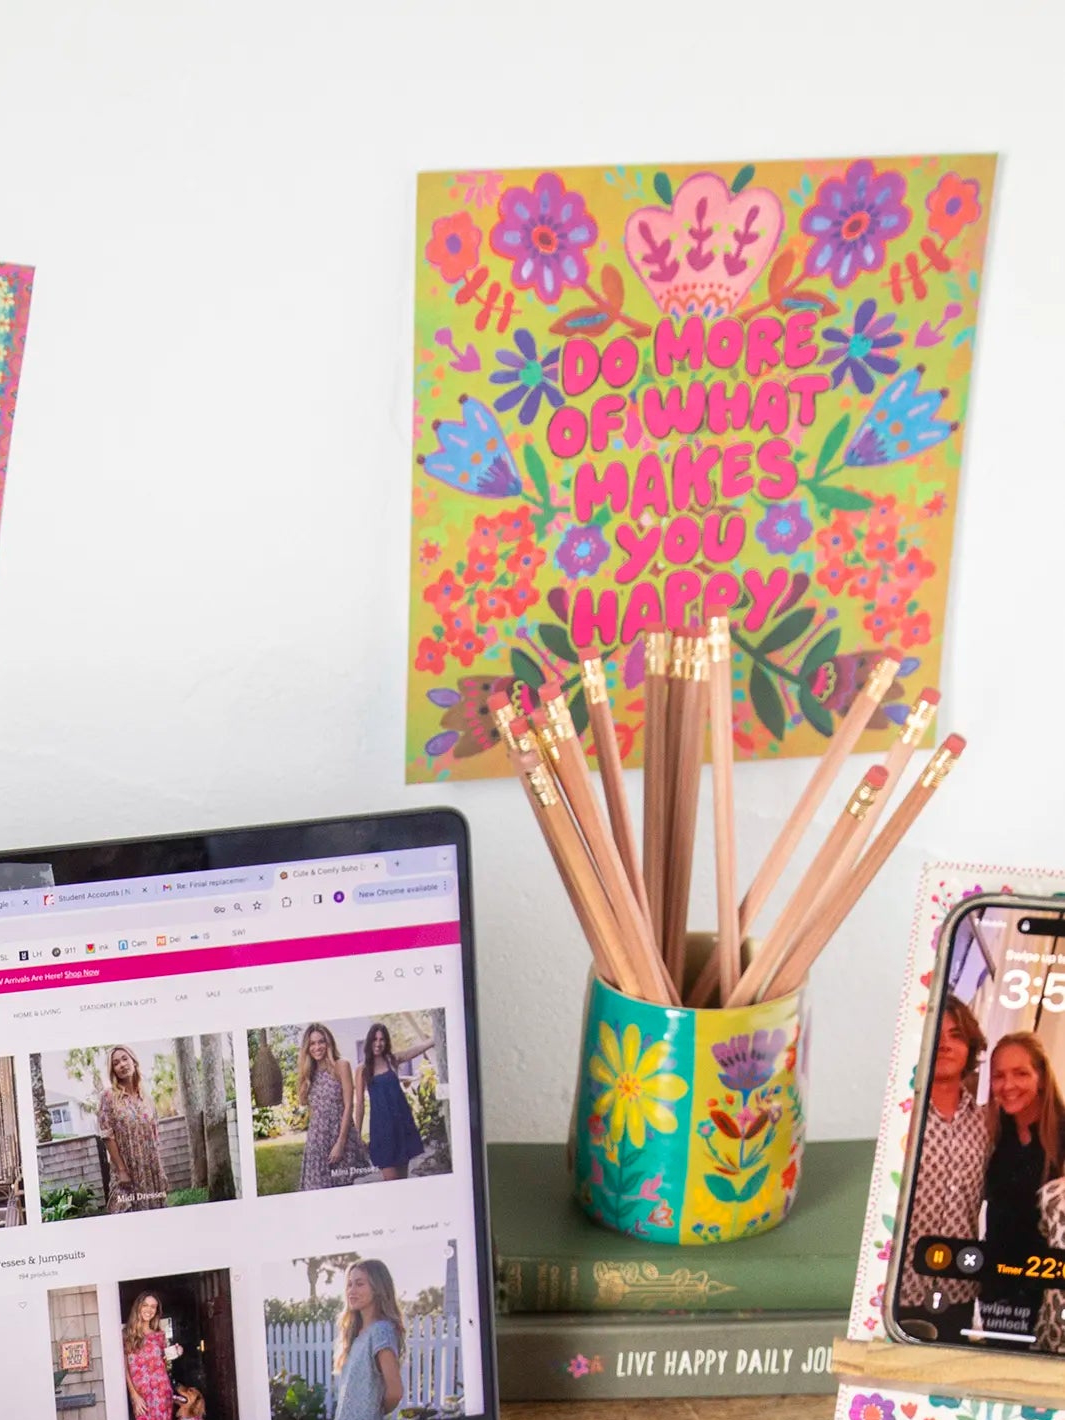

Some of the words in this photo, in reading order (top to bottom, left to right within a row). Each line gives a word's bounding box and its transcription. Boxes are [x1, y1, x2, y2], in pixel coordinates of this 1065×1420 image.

[561, 336, 639, 396] DO
[654, 310, 820, 377] MORE
[546, 393, 626, 459] OF
[643, 374, 831, 438] WHAT
[574, 438, 799, 523] MAKES
[614, 512, 746, 584] YOU
[571, 568, 788, 647] HAPPY
[58, 892, 85, 902] Student
[87, 890, 119, 899] Accounts
[359, 890, 375, 899] New
[376, 886, 404, 897] Chrome
[406, 882, 438, 894] available
[4, 975, 30, 984] Arrivals
[31, 973, 43, 982] Are
[45, 972, 63, 980] Here!
[65, 971, 82, 980] Shop
[84, 969, 99, 977] Now
[13, 1011, 33, 1019] HOME
[117, 1194, 134, 1203] Midi
[136, 1191, 167, 1202] Dresses
[38, 1250, 86, 1265] Jumpsuits
[997, 1264, 1023, 1275] Timer
[1014, 1307, 1031, 1318] up
[986, 1319, 1029, 1331] unlock
[616, 1351, 656, 1377] LIVE
[664, 1349, 728, 1376] HAPPY
[736, 1348, 793, 1375] DAILY
